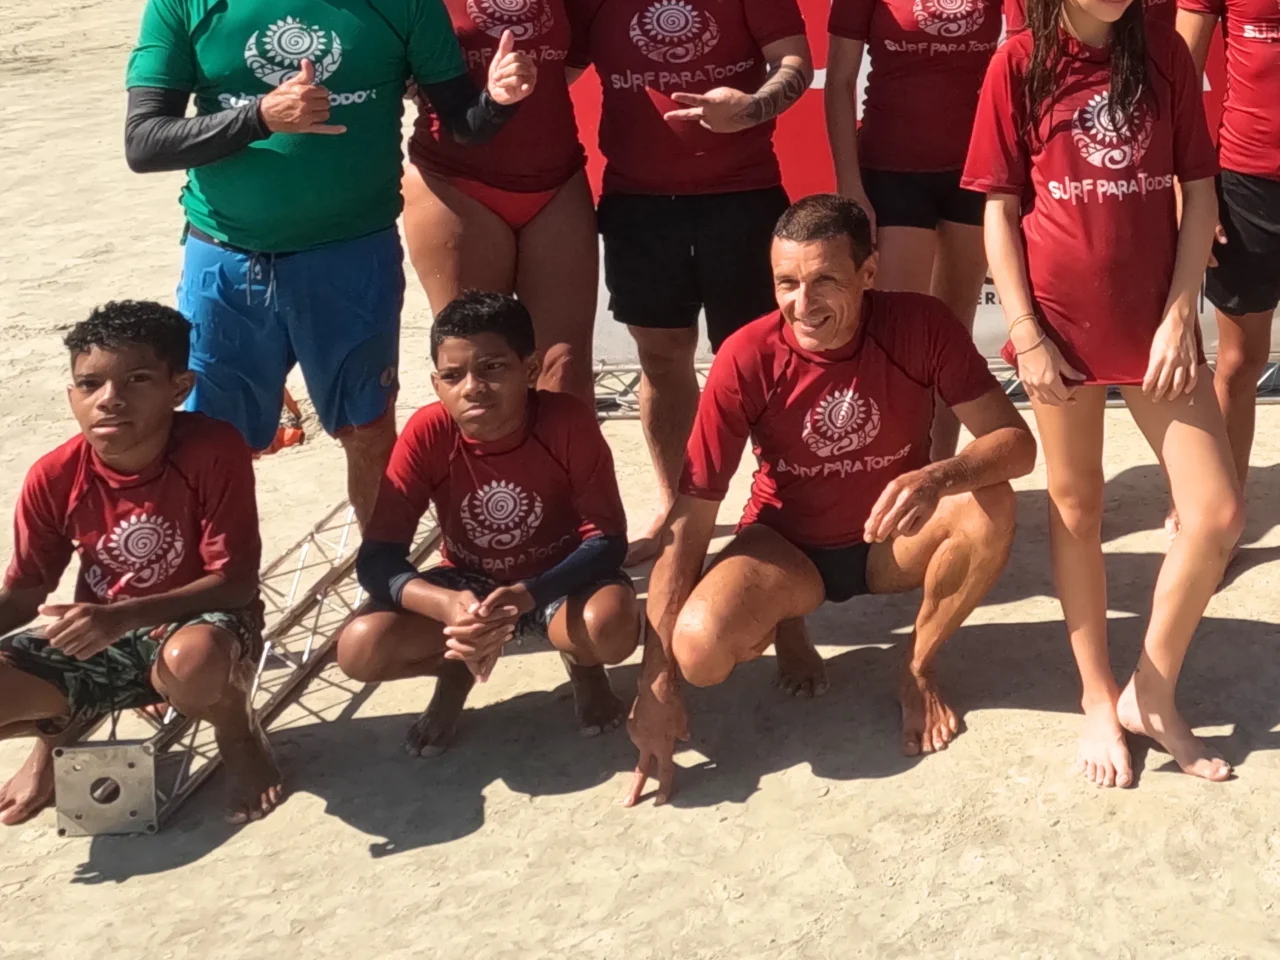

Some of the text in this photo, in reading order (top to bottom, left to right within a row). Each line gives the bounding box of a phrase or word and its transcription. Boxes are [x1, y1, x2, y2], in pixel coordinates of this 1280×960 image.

[930, 42, 966, 56] PARA
[611, 58, 754, 92] SURF PARA TODOS
[1048, 176, 1093, 205] SURF
[1096, 180, 1138, 203] PARA
